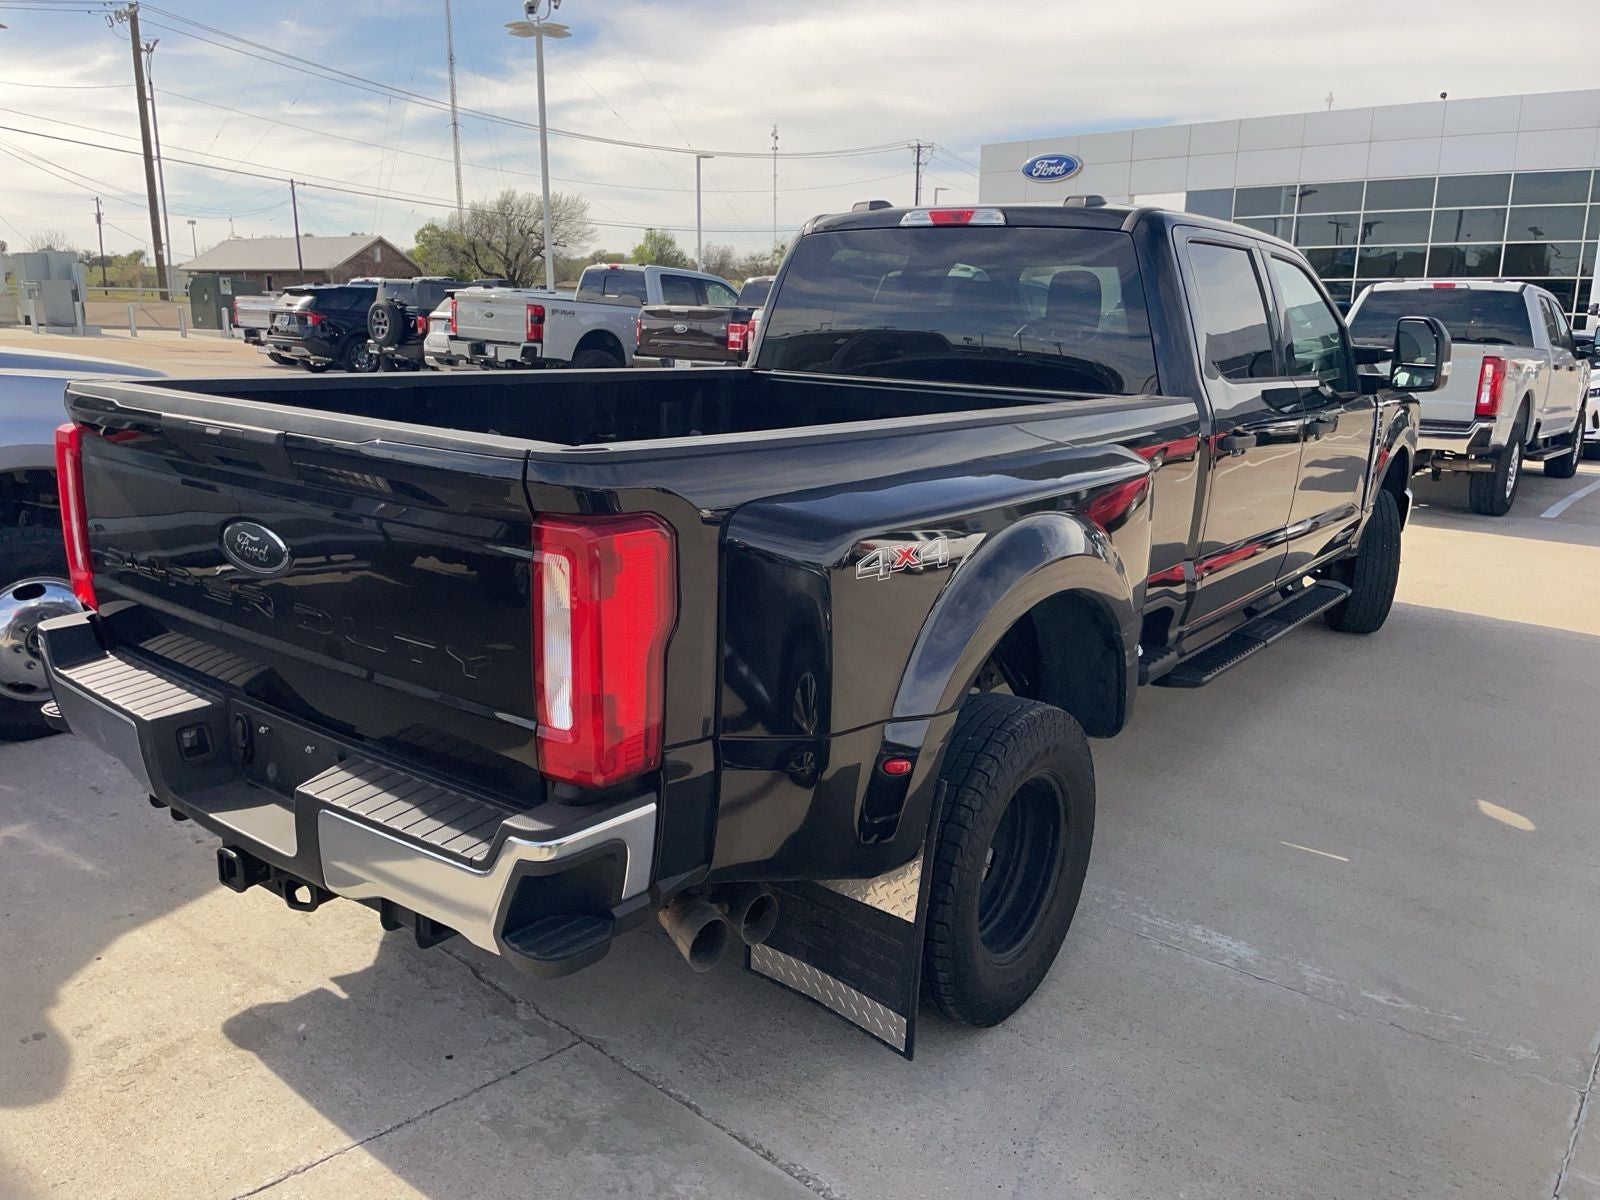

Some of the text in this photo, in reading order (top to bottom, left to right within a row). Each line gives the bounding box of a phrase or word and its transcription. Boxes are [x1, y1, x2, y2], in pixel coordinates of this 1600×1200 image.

[1032, 159, 1067, 176] Ford
[551, 308, 576, 317] FX4
[235, 531, 269, 562] Ford
[102, 547, 494, 680] SUPER DUTY
